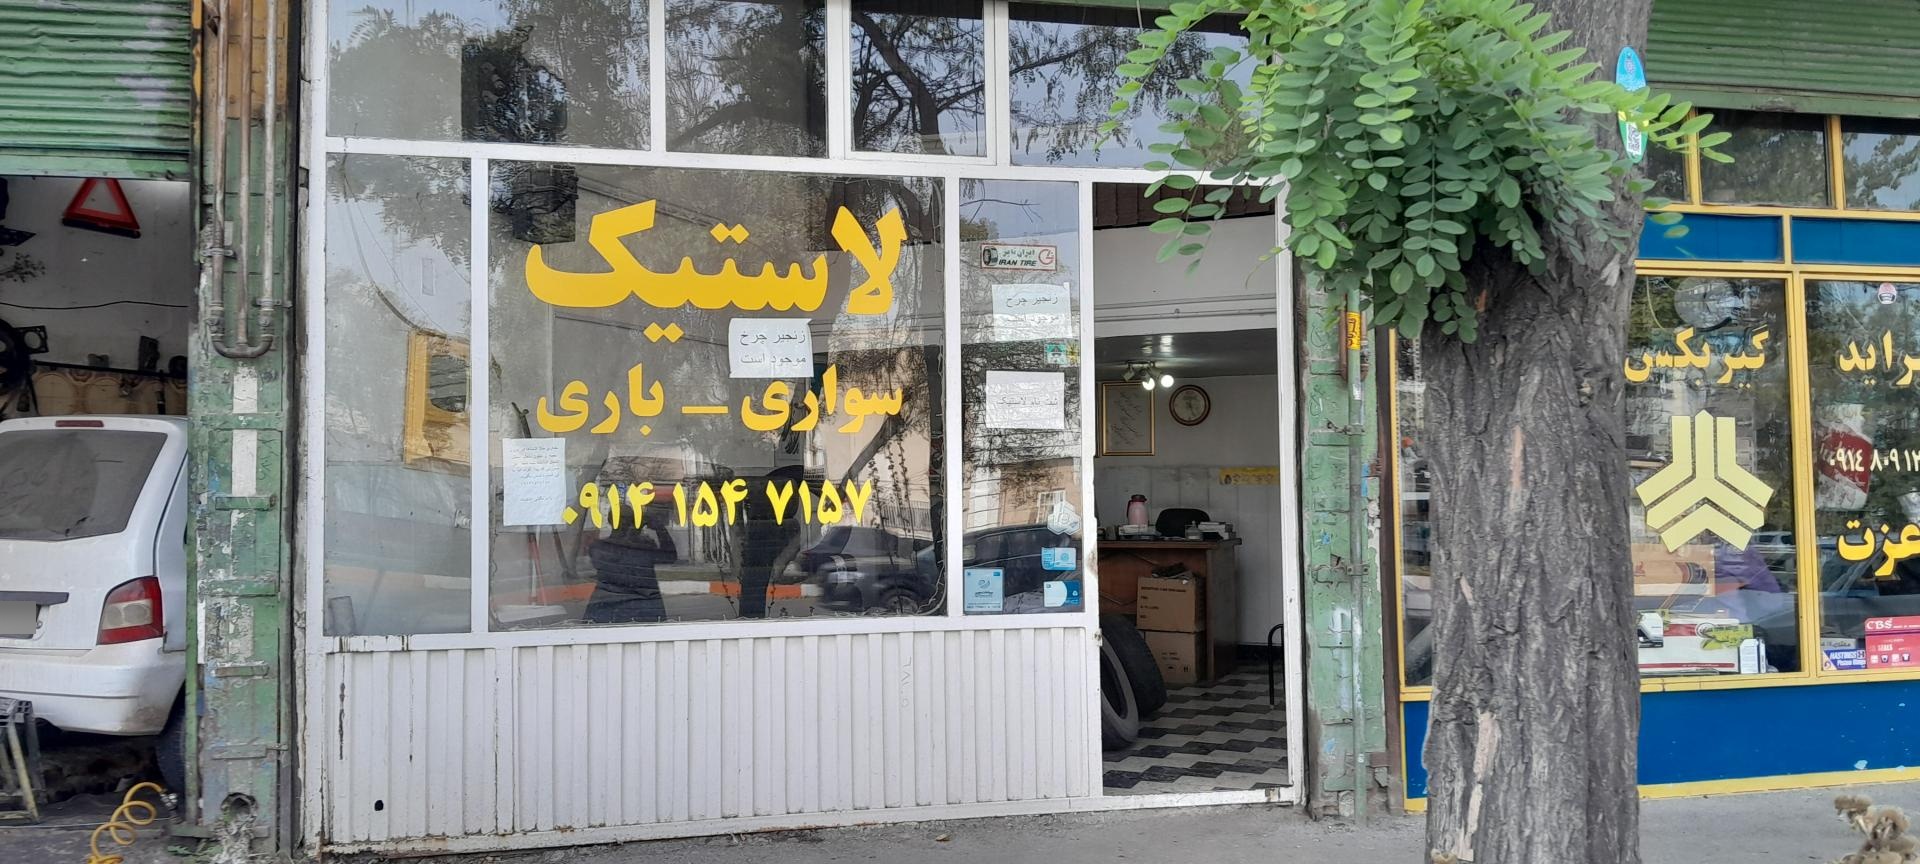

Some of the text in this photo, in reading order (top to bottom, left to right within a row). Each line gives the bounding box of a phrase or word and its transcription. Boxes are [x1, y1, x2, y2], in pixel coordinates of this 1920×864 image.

[525, 199, 908, 343] لاستیک
[740, 329, 806, 346] زنجیر چرخ
[740, 352, 807, 367] موجود است
[1839, 329, 1920, 385] راید
[536, 364, 666, 437] باری
[740, 364, 904, 434] سواری
[562, 478, 873, 530] ۰۹۱۴ ۱۵۴ ۷۱۵۷
[1866, 619, 1893, 629] CBS
